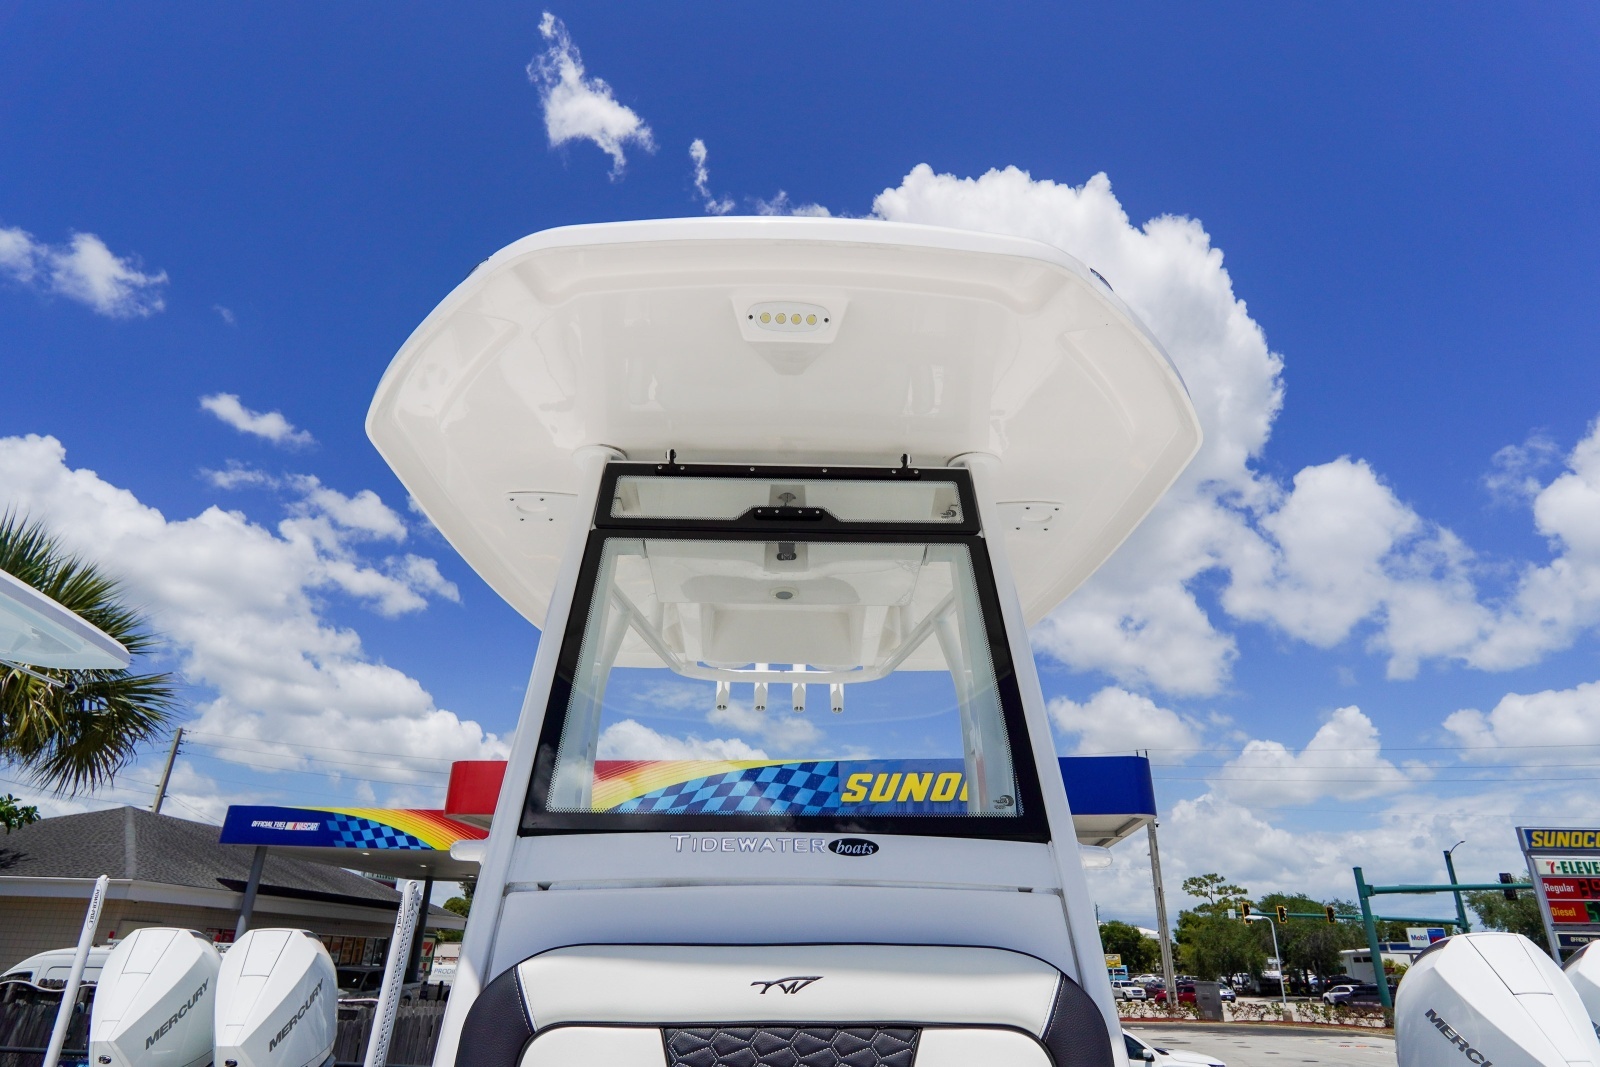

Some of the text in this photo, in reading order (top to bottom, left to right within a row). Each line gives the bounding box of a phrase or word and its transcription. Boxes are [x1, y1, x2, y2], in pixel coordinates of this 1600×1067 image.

[251, 820, 273, 828] OFFICIAL
[835, 840, 873, 855] boats
[1544, 882, 1575, 894] Regular
[1551, 907, 1576, 917] Diesel
[145, 977, 209, 1050] MERCURY
[269, 978, 323, 1053] MERCURY
